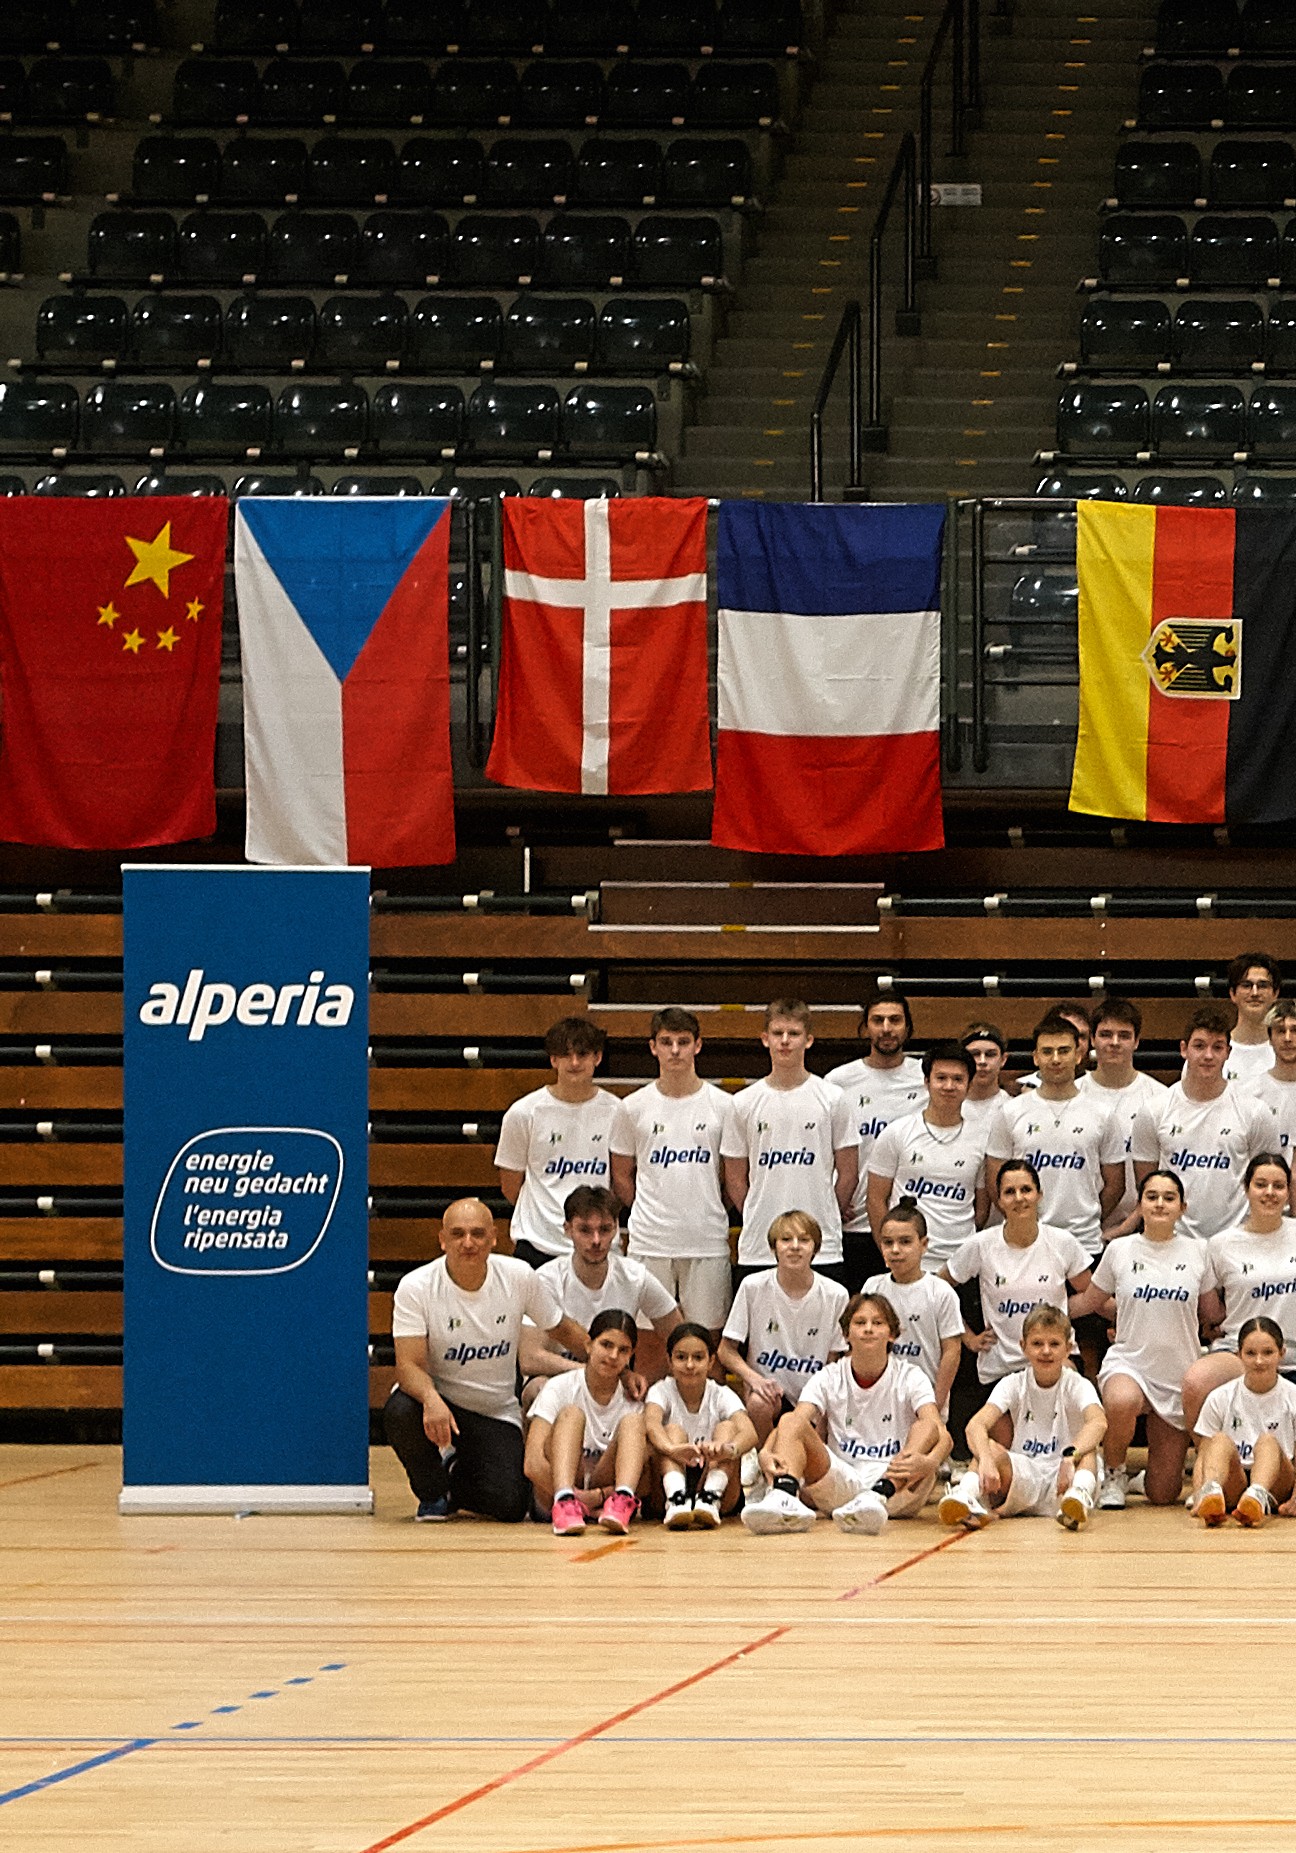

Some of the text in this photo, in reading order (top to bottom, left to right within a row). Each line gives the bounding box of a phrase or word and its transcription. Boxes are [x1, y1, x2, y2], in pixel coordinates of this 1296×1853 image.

[139, 969, 355, 1041] alperia
[185, 1150, 274, 1175] energie
[545, 1156, 607, 1179] alperia
[650, 1146, 710, 1168] alperia
[758, 1147, 815, 1169] aperia
[1025, 1149, 1085, 1172] alperia
[1170, 1149, 1230, 1171] alperia
[184, 1172, 329, 1197] neu gedacht
[905, 1176, 966, 1200] alperia
[183, 1204, 282, 1230] l'energia
[183, 1227, 289, 1252] ripensata
[1133, 1285, 1189, 1302] alperia
[444, 1340, 510, 1365] alperia
[757, 1350, 823, 1374] alperia
[838, 1438, 901, 1458] alperia
